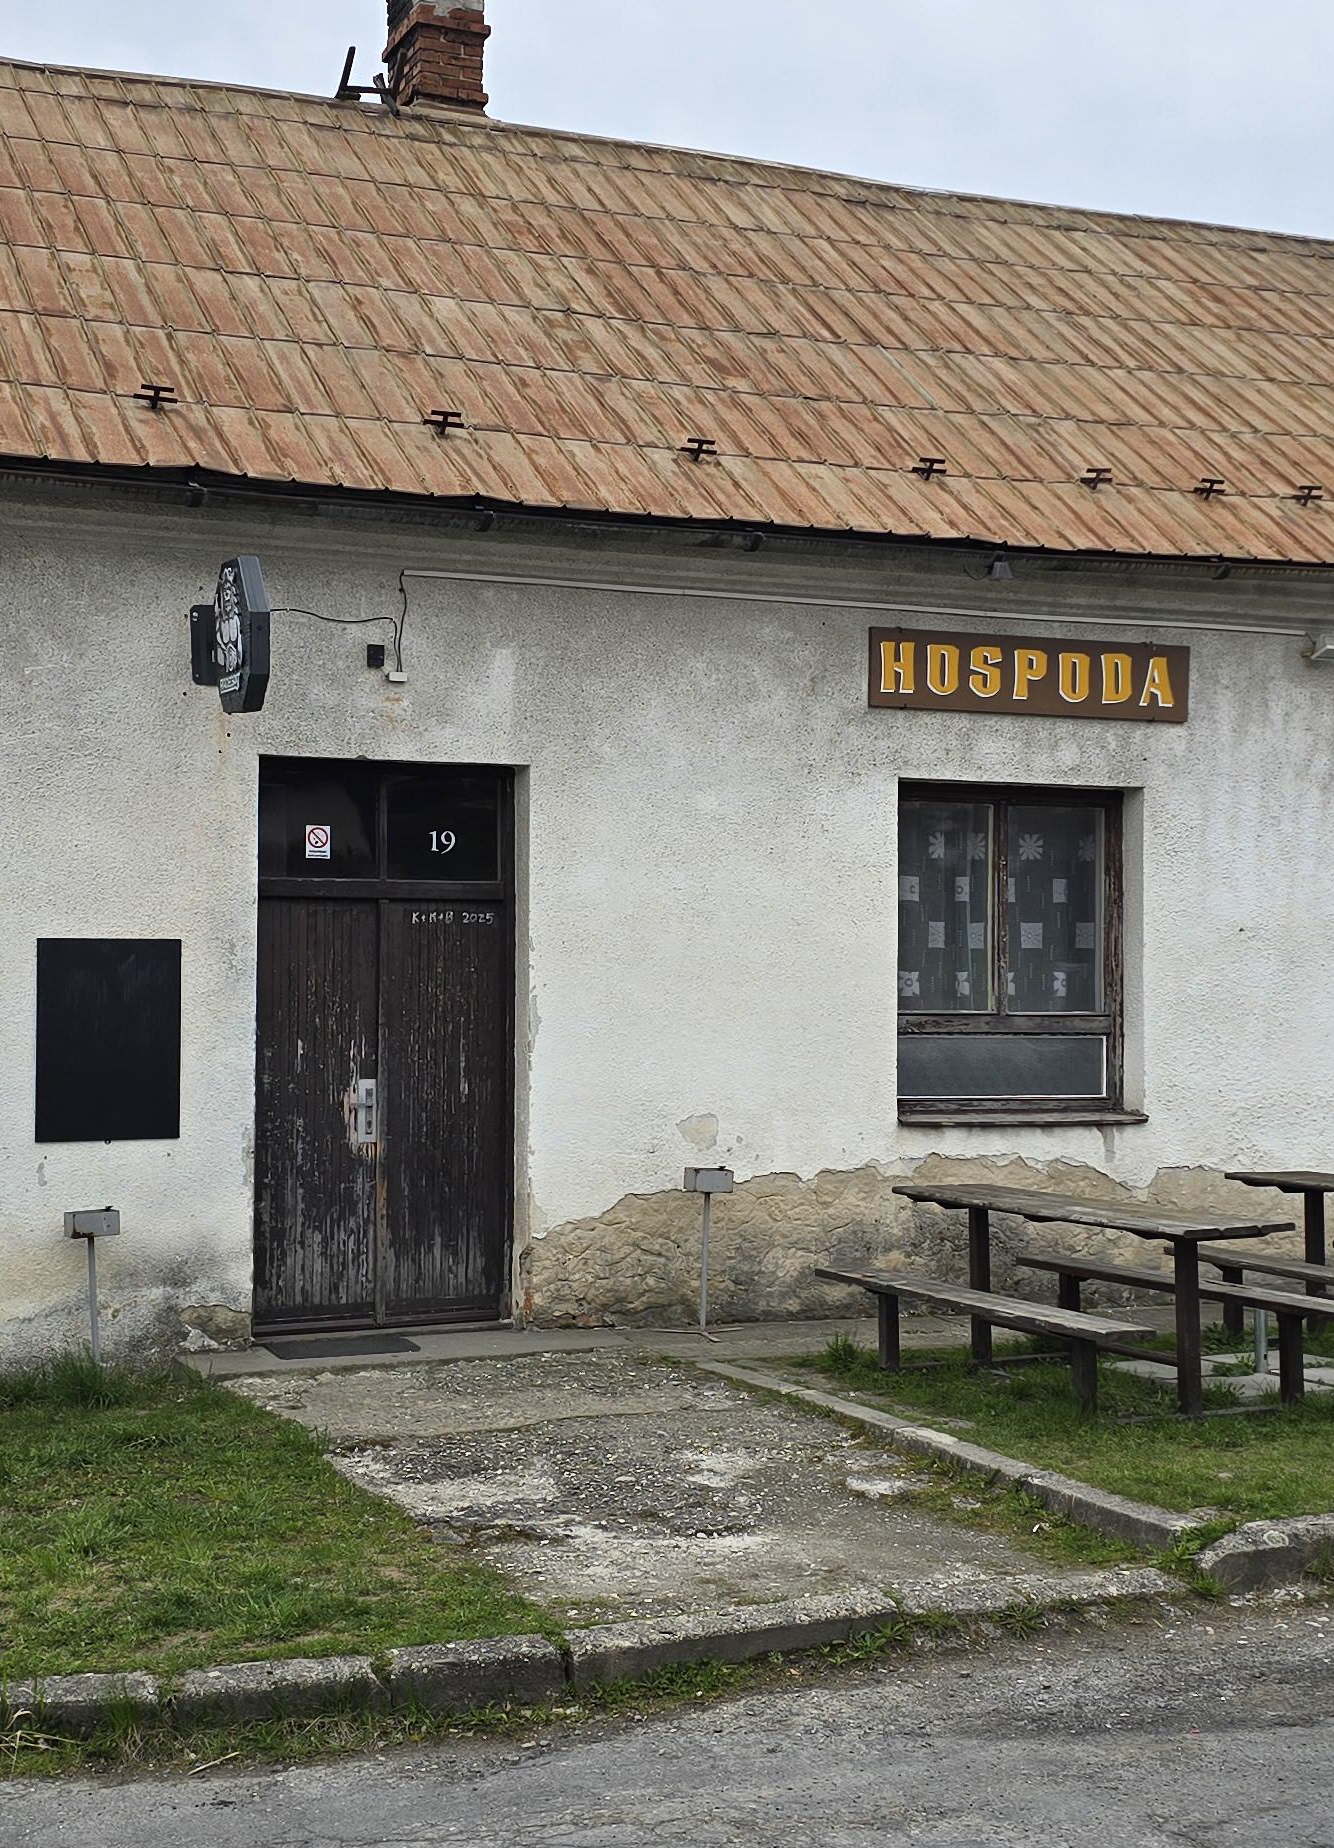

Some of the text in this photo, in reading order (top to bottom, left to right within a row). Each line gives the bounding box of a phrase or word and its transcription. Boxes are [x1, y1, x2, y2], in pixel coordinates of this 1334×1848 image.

[880, 641, 1175, 708] HOSPODA
[429, 830, 456, 855] 19
[462, 912, 495, 925] 2025
